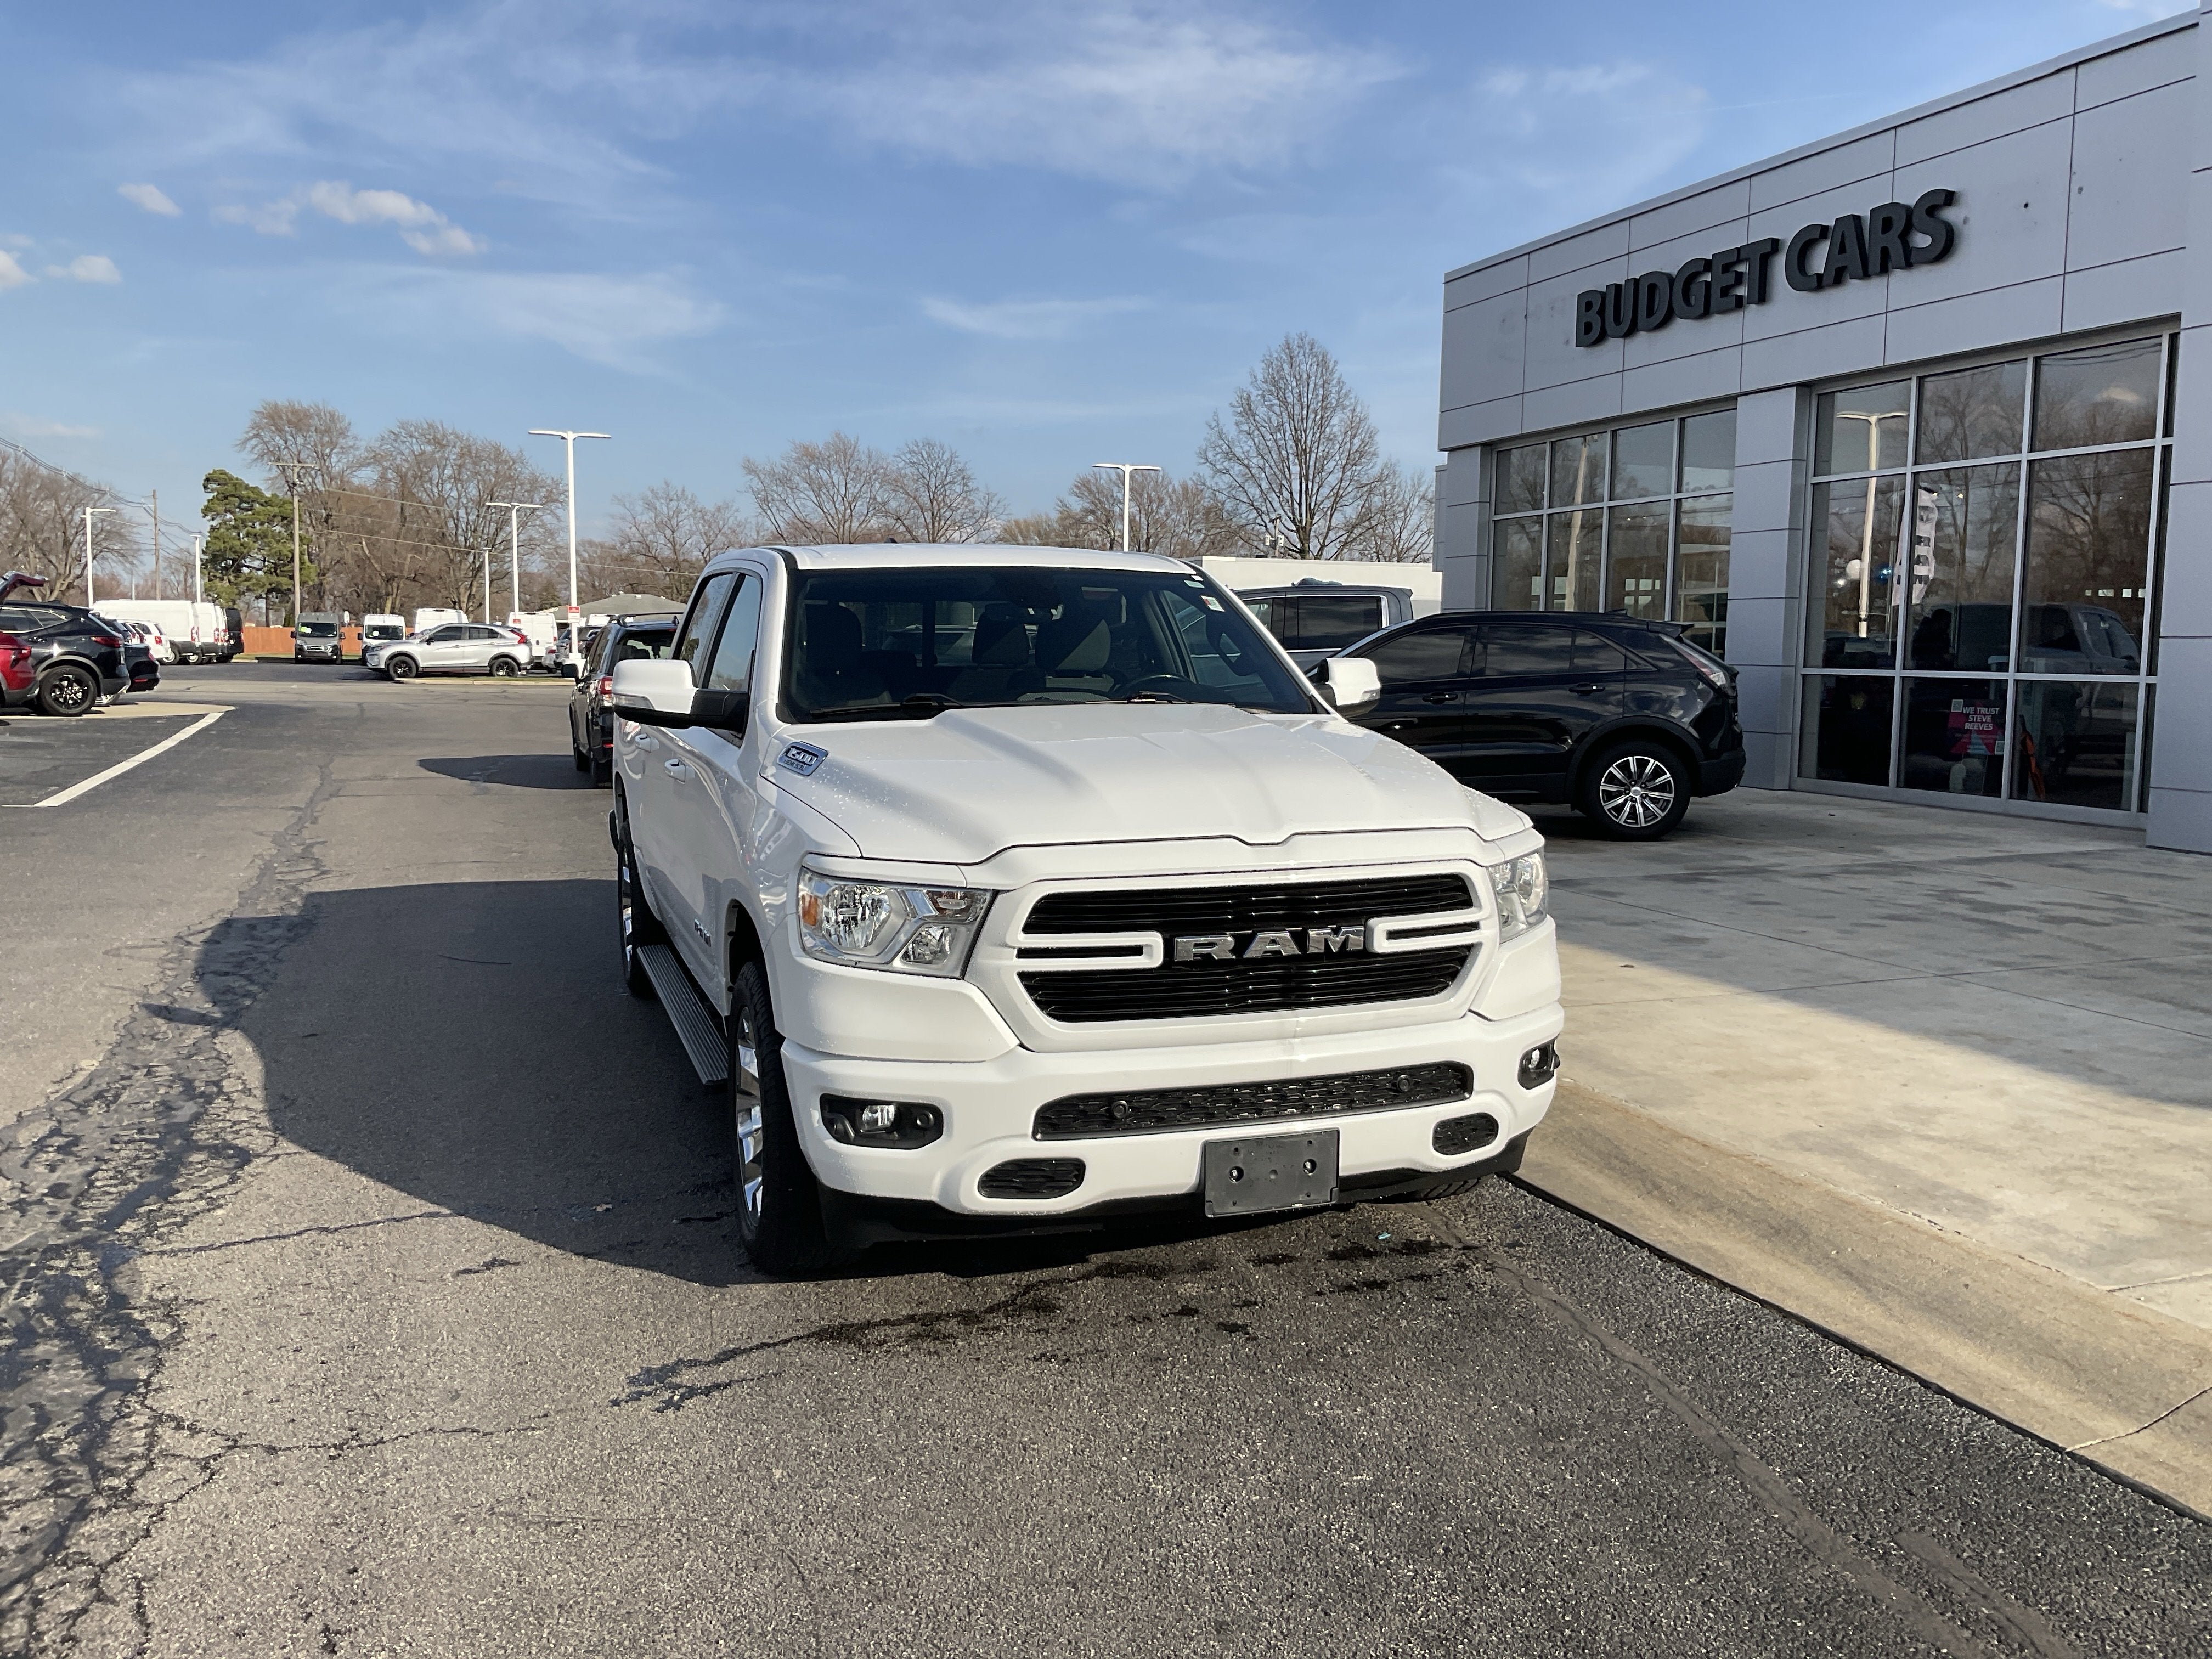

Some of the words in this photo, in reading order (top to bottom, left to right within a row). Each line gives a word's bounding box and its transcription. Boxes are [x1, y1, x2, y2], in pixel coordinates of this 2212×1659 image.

[1575, 237, 1779, 347] BUDGET
[1785, 188, 1955, 292] CARS
[787, 748, 817, 765] 1500
[1174, 925, 1365, 962] RAM
